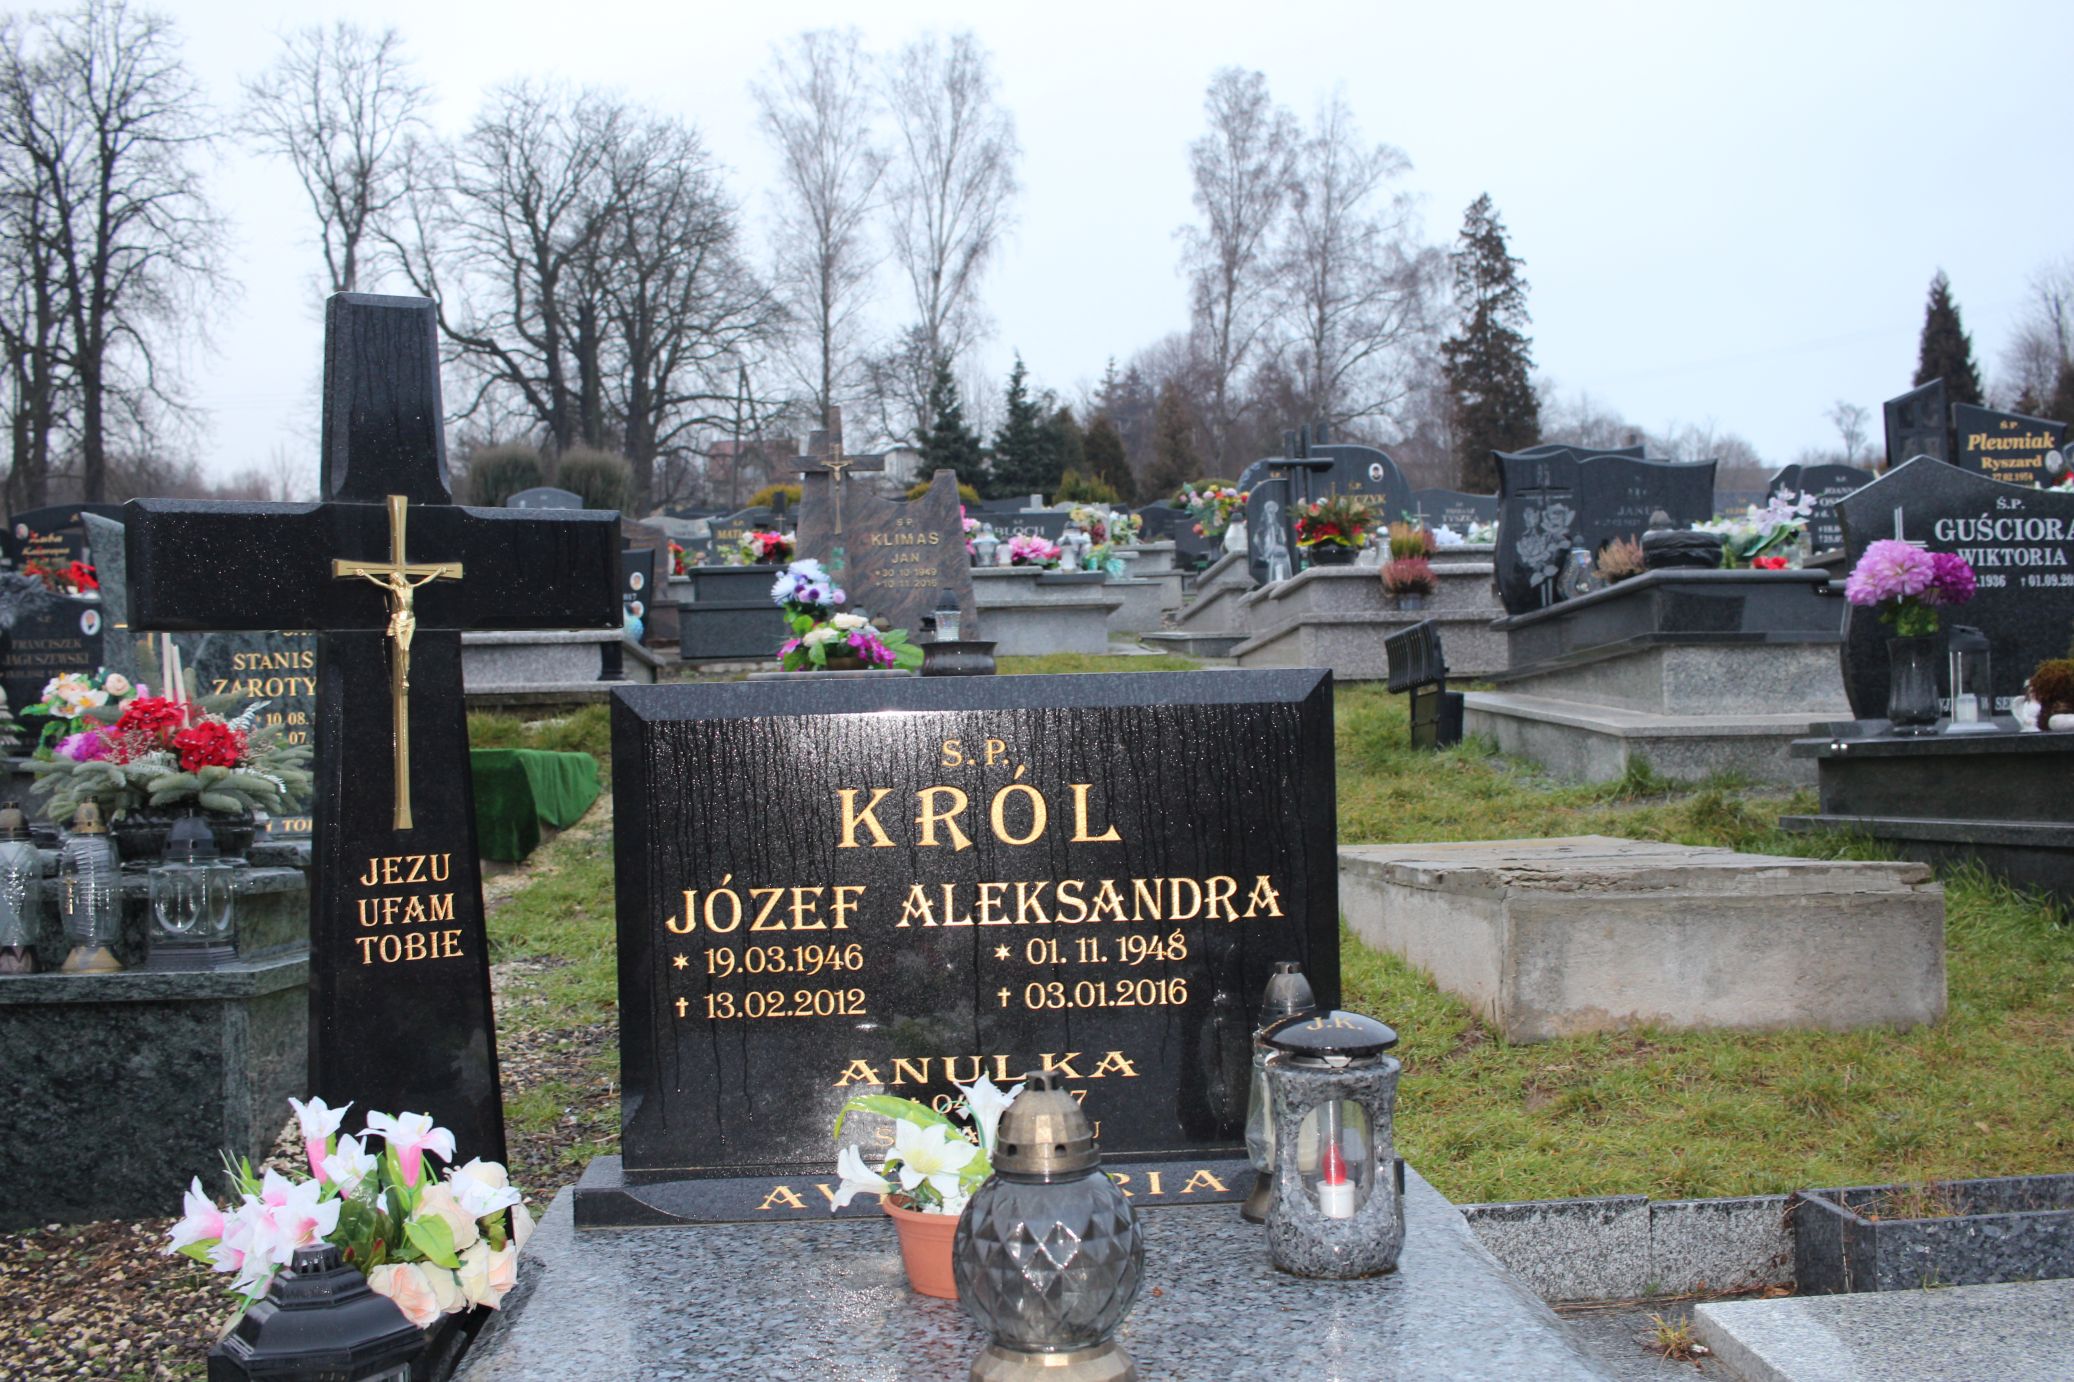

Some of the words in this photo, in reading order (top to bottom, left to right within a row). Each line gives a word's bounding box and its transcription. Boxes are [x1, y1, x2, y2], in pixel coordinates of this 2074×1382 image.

[1967, 431, 2055, 451] Plewniak
[1981, 455, 2042, 471] Ryszard
[871, 532, 940, 546] KLIMAS
[891, 553, 920, 564] JAN
[1957, 547, 2068, 567] WIKTORIA
[836, 764, 1123, 853] KRÓL
[360, 852, 452, 887] JEZU
[357, 892, 456, 927] UFAM
[665, 872, 868, 934] JÓZEF
[895, 874, 1286, 928] ALEKSANDRA
[354, 929, 465, 965] TOBIE
[703, 943, 865, 978] 19.03.1946
[703, 988, 867, 1019] 13.02.2012
[1024, 978, 1188, 1010] 03.01.2016
[1306, 1016, 1364, 1031] J.K.
[832, 1050, 1141, 1087] ANULKA
